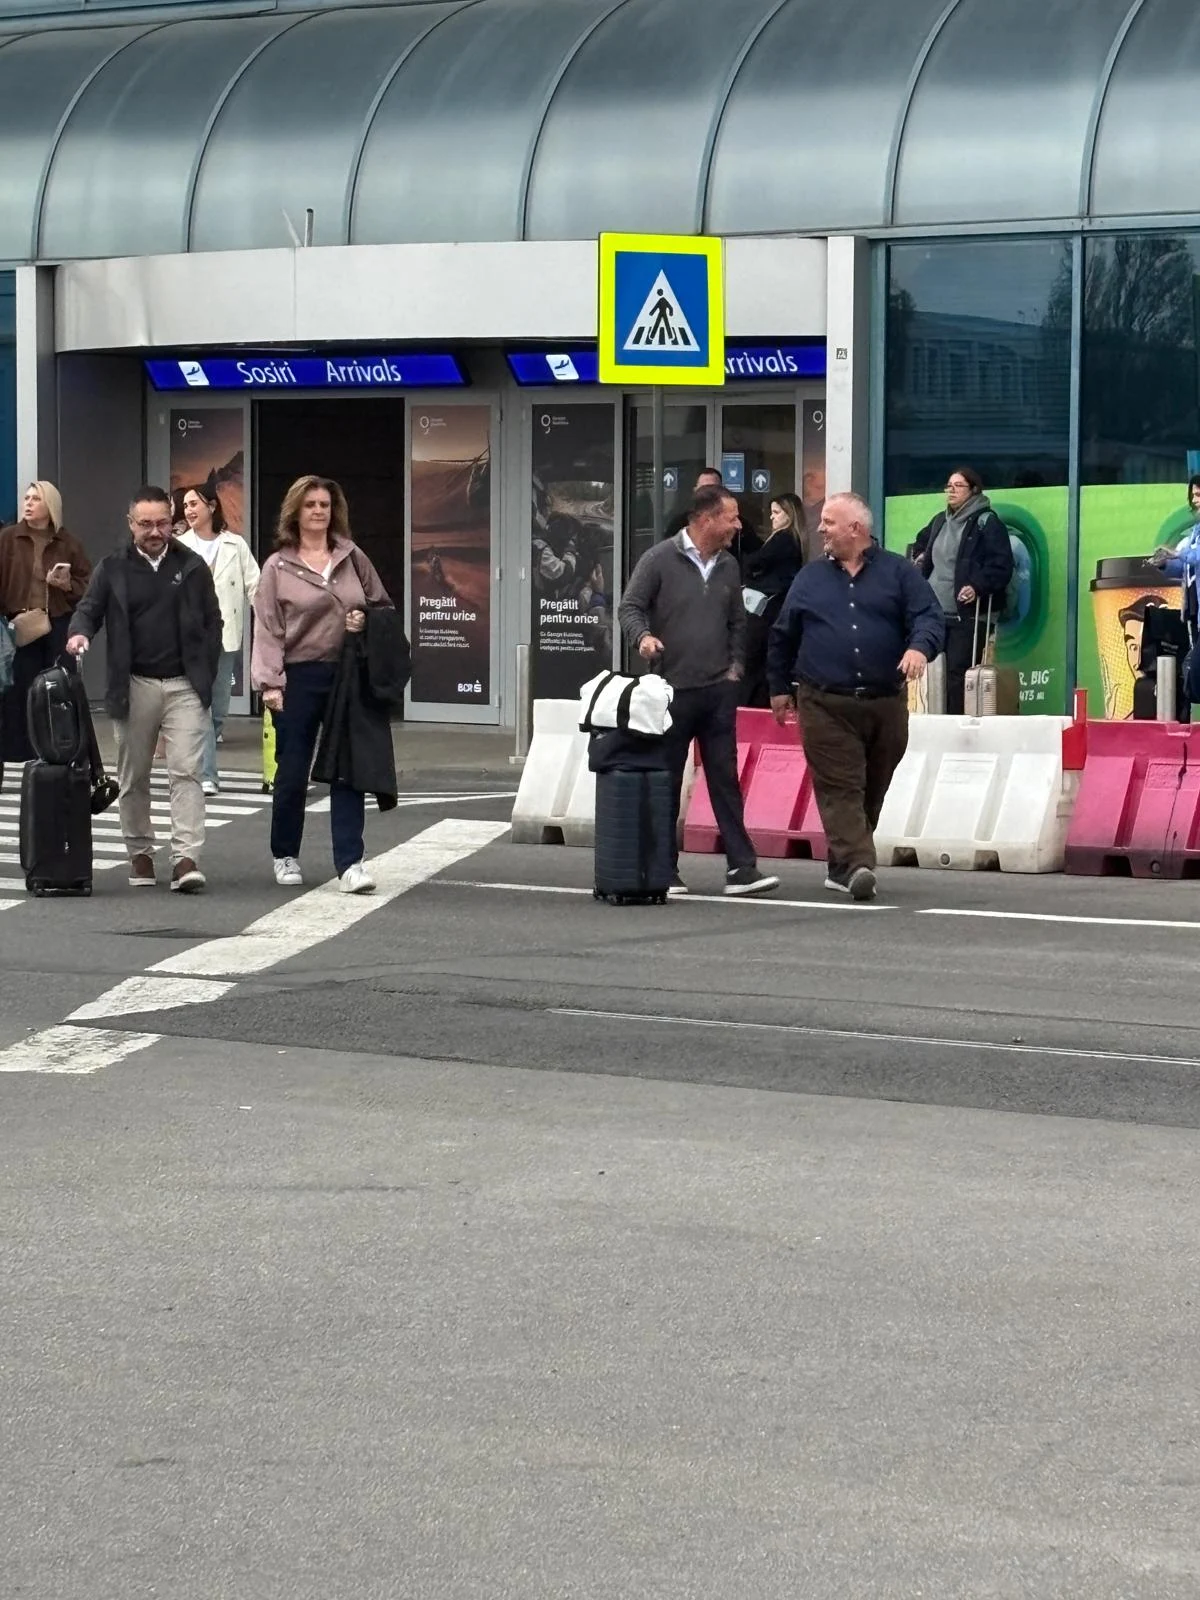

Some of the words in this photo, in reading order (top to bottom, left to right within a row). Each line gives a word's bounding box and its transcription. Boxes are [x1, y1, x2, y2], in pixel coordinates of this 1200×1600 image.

[723, 349, 798, 374] rrivals
[236, 360, 297, 384] Sosiri
[326, 358, 402, 383] Arrivals
[419, 596, 457, 609] Pregătit
[540, 598, 579, 612] Pregătit
[419, 611, 451, 623] pentru
[452, 610, 476, 622] orice
[540, 614, 572, 626] pentru
[574, 613, 599, 624] orice
[1030, 669, 1050, 685] BIG
